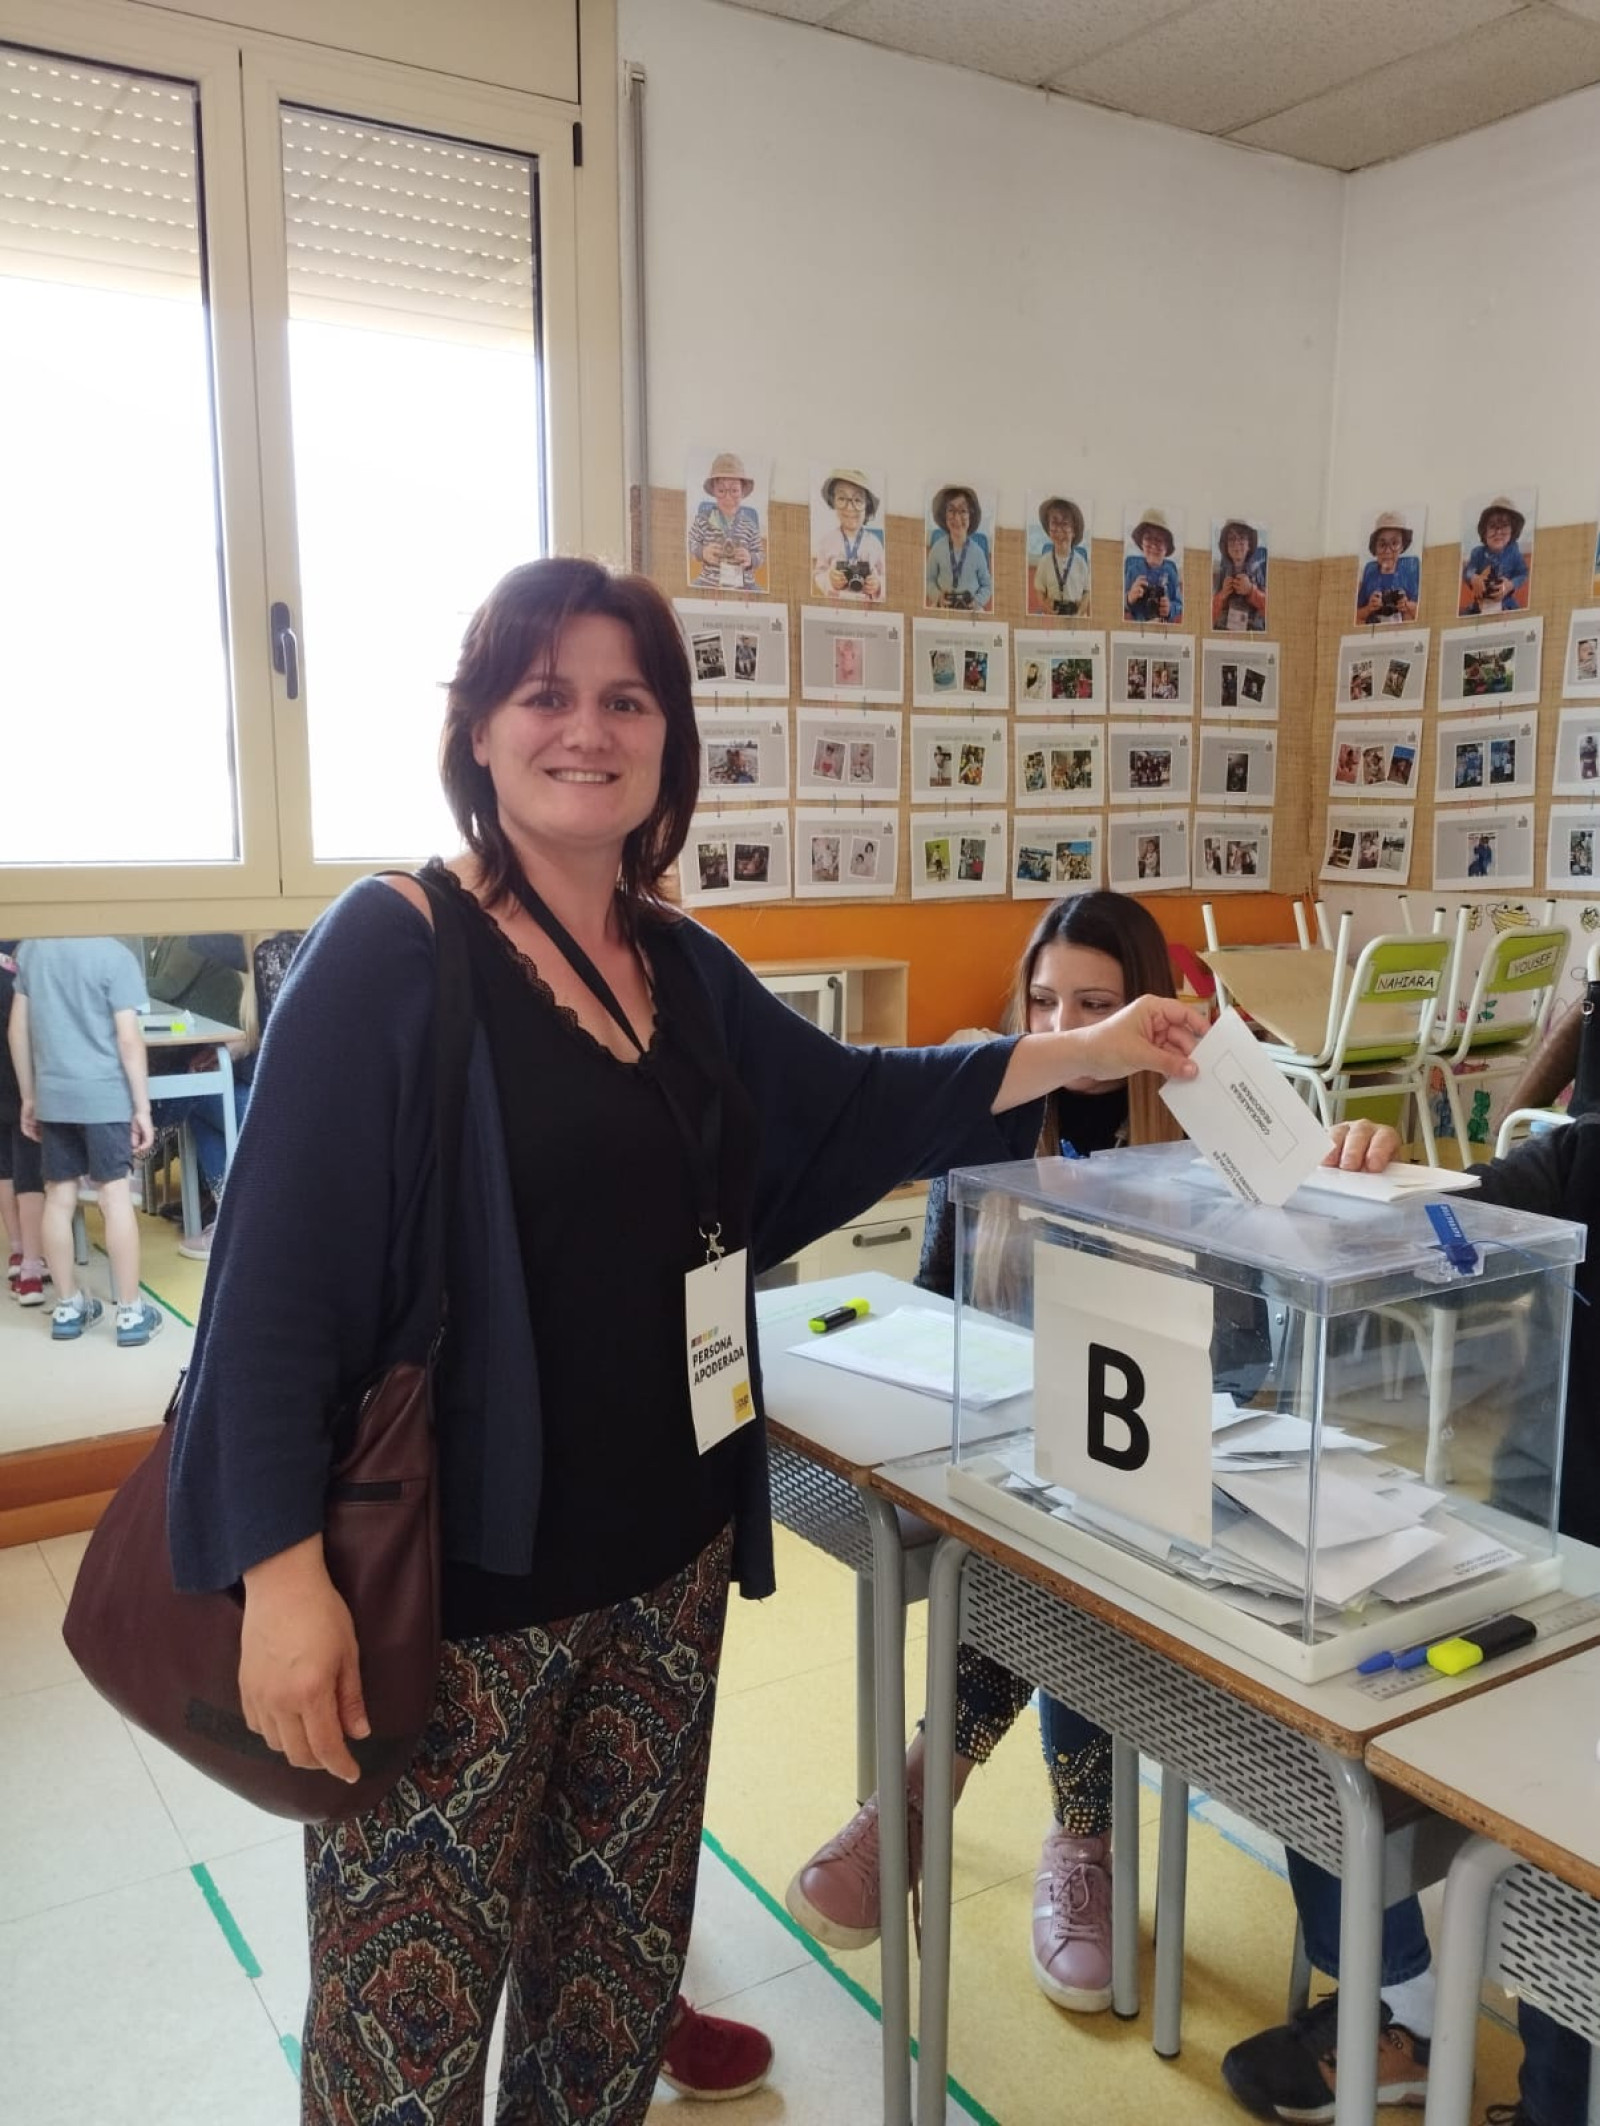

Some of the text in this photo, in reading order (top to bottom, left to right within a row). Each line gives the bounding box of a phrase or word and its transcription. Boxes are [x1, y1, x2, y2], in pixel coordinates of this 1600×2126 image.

[1377, 974, 1434, 991] NAHIARA
[693, 1334, 733, 1369] PERSONA
[694, 1345, 745, 1387] APODERADA
[1087, 1342, 1151, 1472] B
